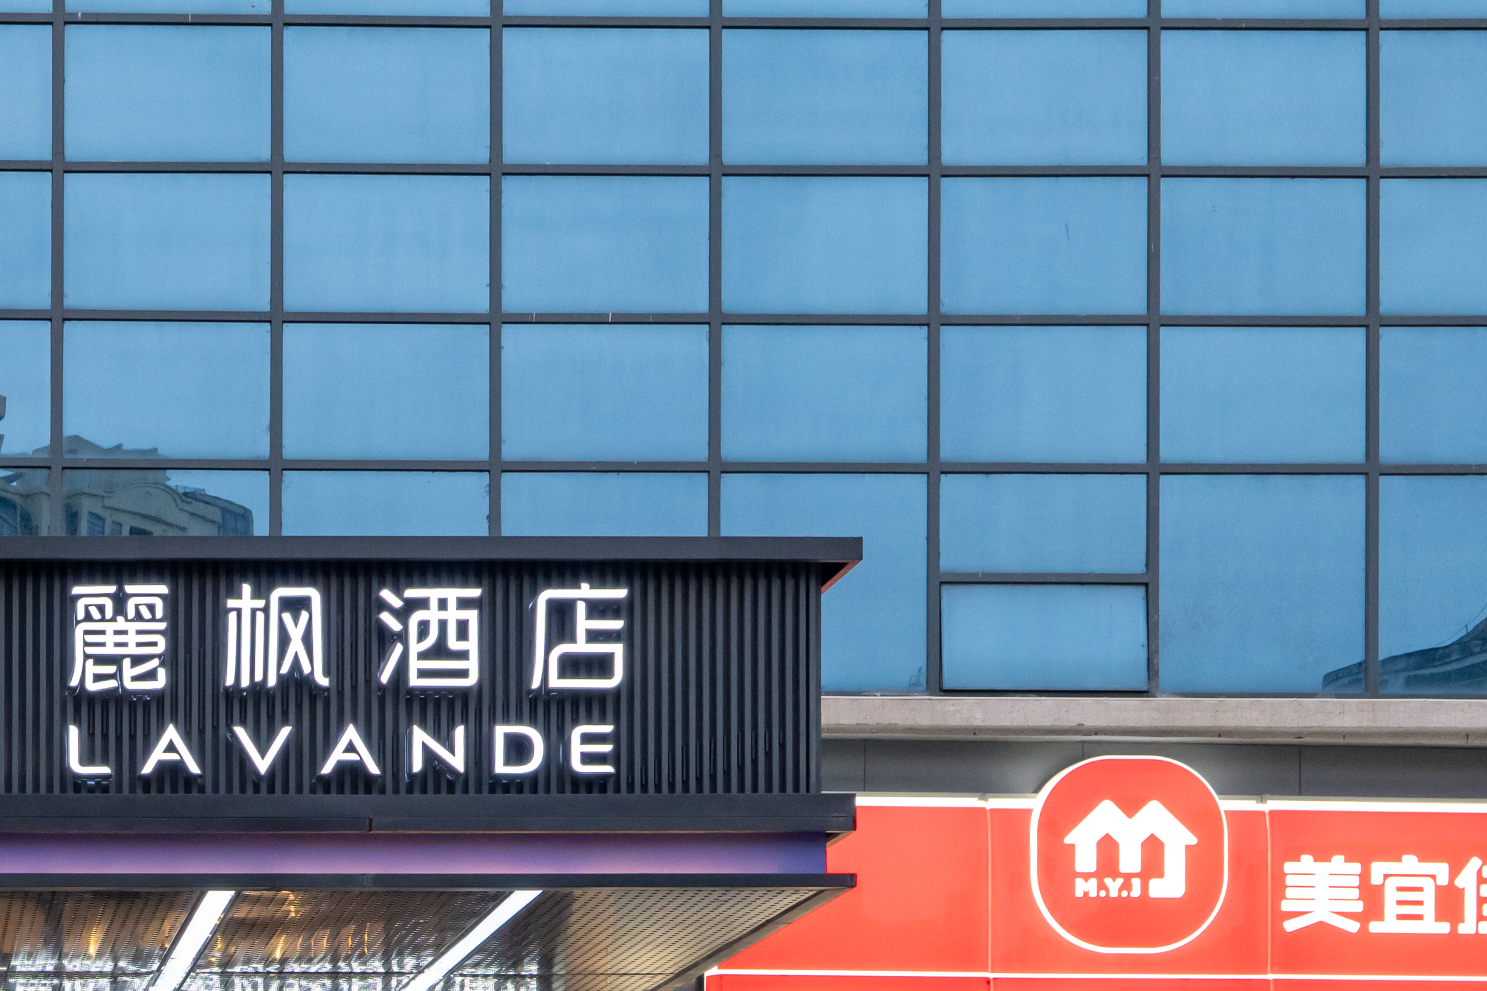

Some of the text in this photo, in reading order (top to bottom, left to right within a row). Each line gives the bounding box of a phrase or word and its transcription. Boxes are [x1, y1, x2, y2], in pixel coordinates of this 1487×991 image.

[68, 582, 628, 690] 麗枫酒店
[67, 723, 616, 775] LAVANDE
[1075, 877, 1141, 898] M.Y.J
